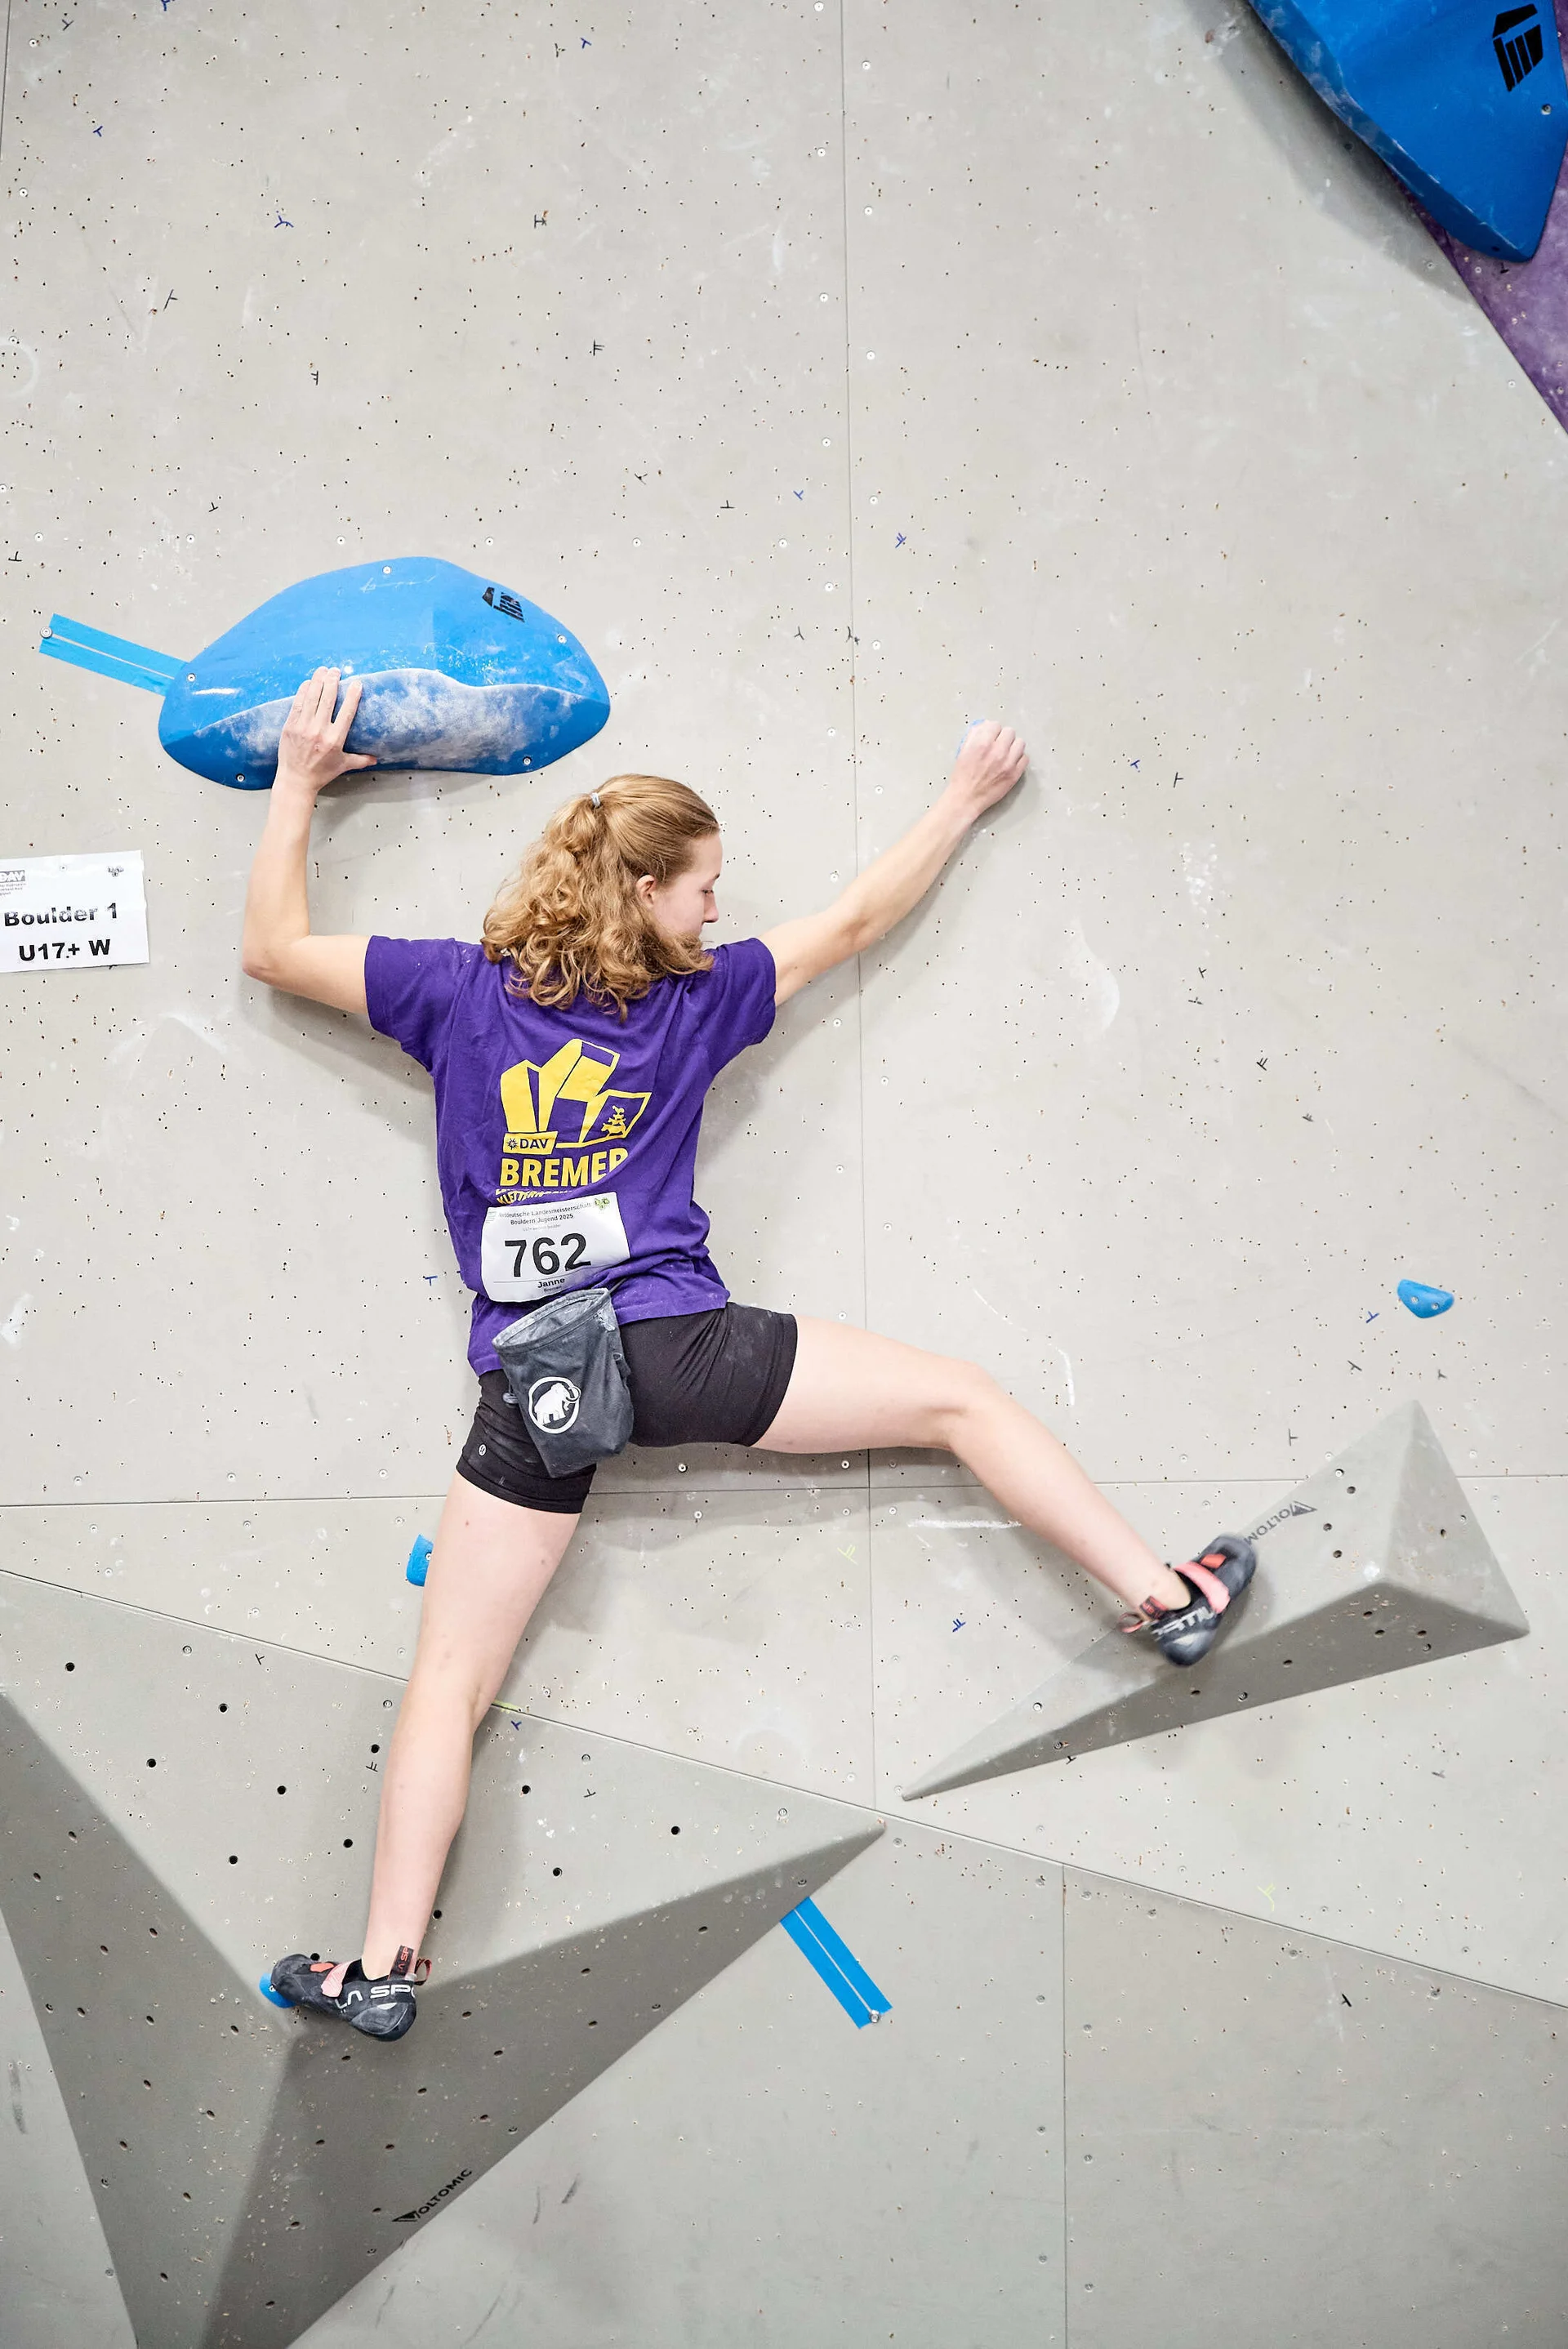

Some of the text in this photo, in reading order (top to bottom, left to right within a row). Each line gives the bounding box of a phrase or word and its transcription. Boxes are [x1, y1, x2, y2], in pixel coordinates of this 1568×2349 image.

[4, 903, 118, 927] Boulder 1
[88, 938, 111, 956] W
[519, 1139, 549, 1149] DAV
[504, 1232, 591, 1277] 762
[537, 1278, 565, 1288] Janne
[1243, 1500, 1318, 1545] VOLTOM
[335, 1989, 363, 2010] LA
